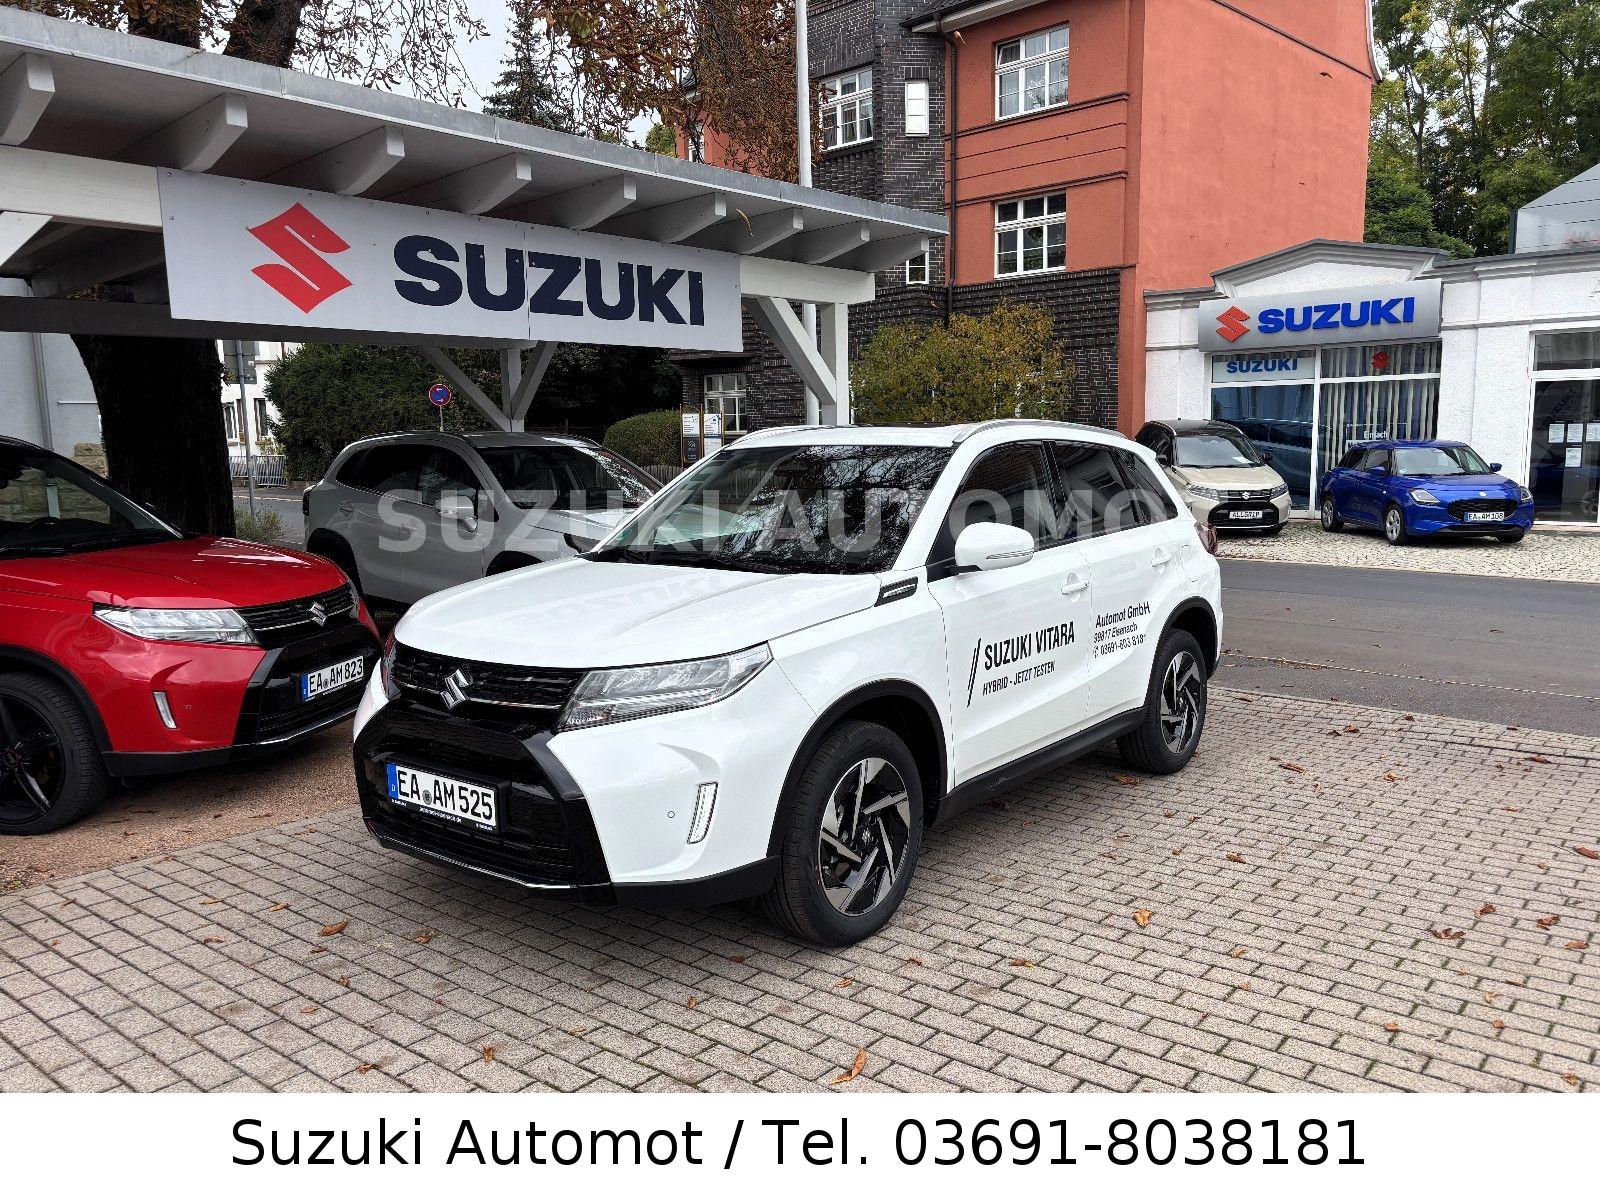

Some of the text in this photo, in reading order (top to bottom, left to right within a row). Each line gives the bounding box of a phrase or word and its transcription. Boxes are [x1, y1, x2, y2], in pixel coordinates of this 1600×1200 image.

[394, 235, 704, 326] SUZUKI
[1258, 296, 1416, 334] SUZUKI
[1226, 358, 1298, 374] SUZUKI
[1095, 601, 1151, 629] Automot GmbH
[984, 621, 1075, 671] SUZUKI VITARA
[983, 676, 1009, 696] HYBRID
[1014, 668, 1033, 686] JETZT
[1033, 660, 1056, 679] TESTEN
[398, 769, 421, 801] EA
